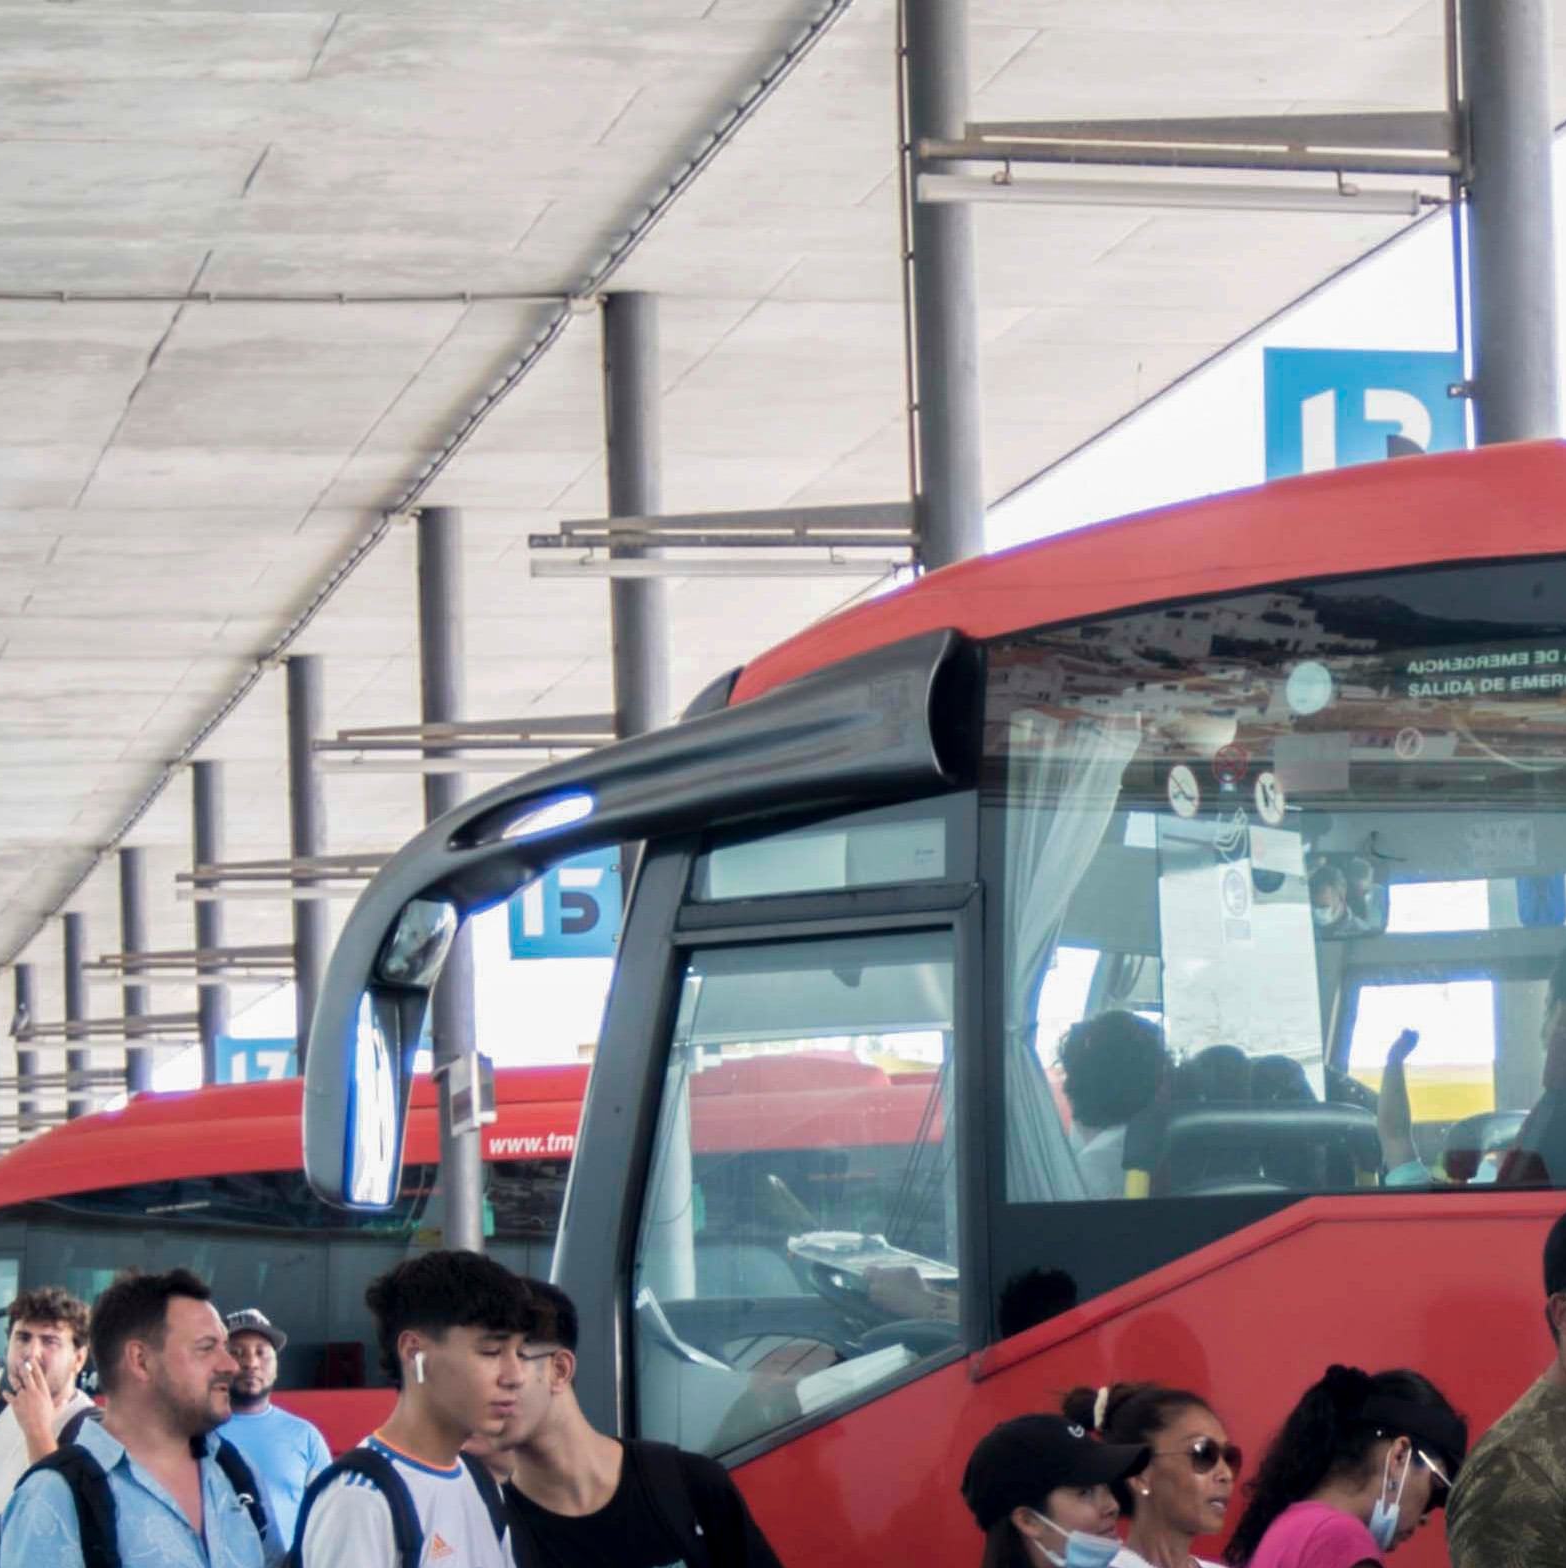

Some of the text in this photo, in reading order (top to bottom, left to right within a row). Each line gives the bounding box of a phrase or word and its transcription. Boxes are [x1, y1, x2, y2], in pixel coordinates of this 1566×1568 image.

[1407, 679, 1475, 698] SALIDA
[1479, 677, 1505, 693] DE
[521, 867, 604, 936] 15
[230, 1050, 291, 1084] 17
